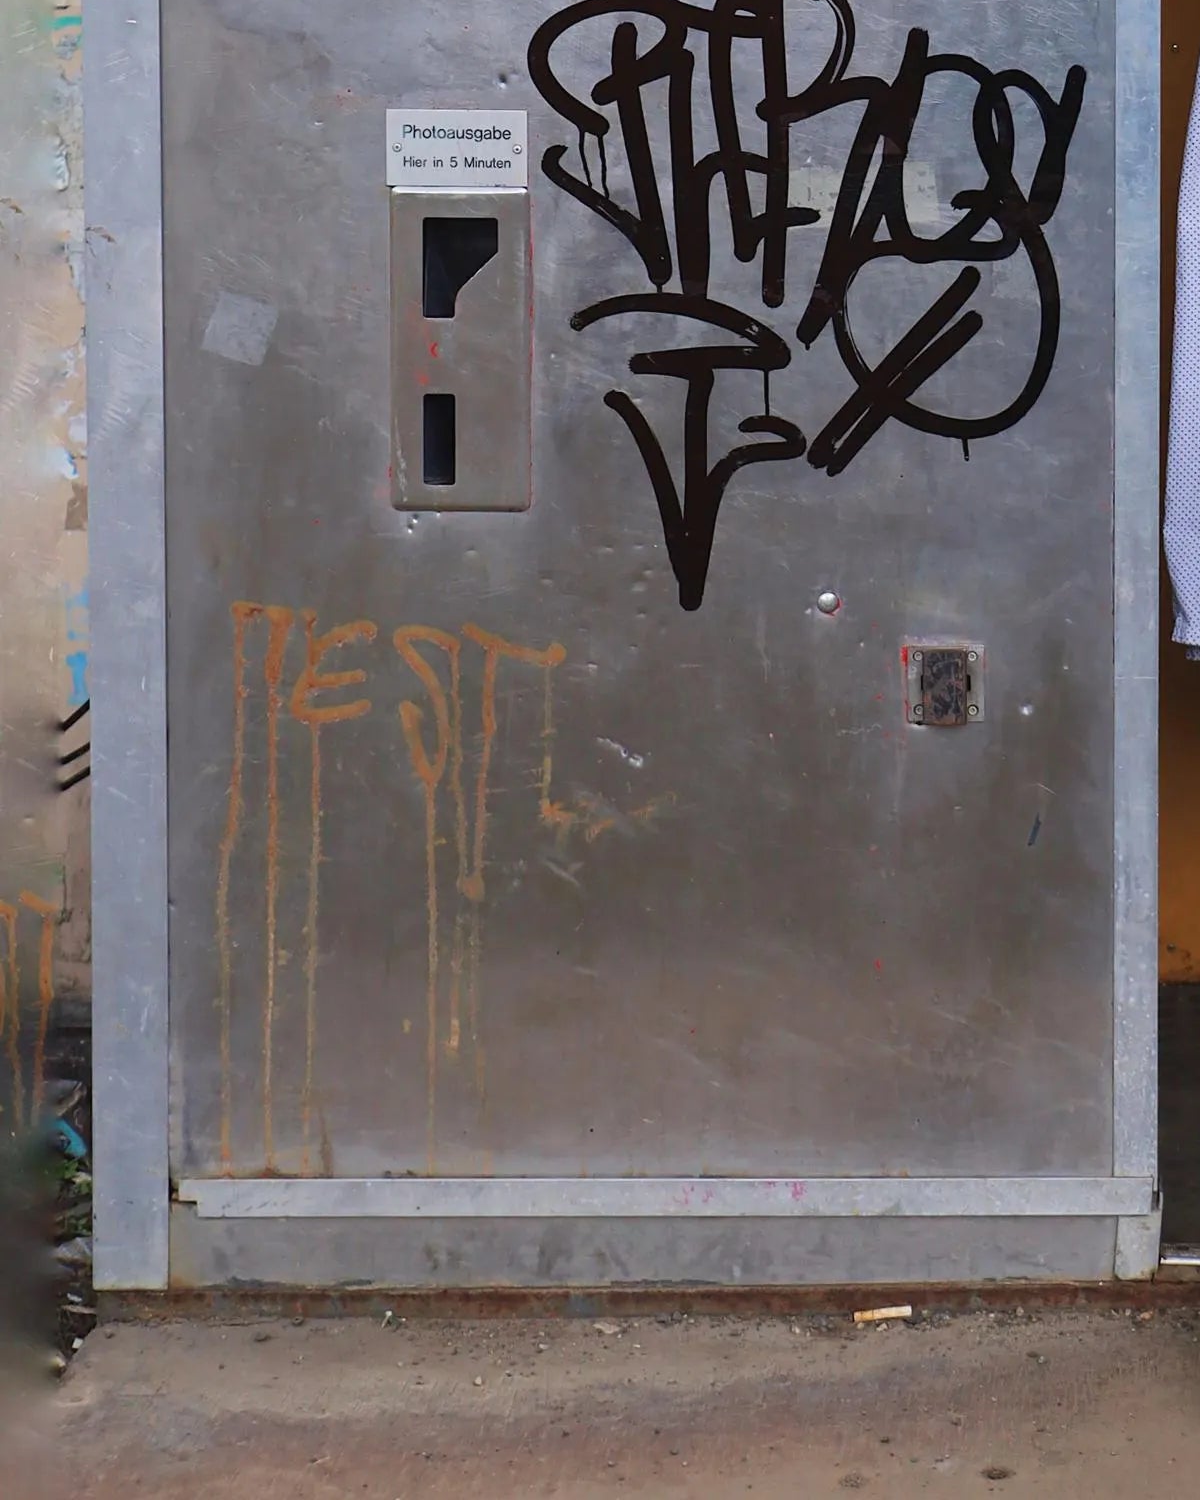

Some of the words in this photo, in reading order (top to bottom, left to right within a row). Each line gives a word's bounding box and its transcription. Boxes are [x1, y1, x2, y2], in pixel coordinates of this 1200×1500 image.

[402, 124, 512, 142] Photoausgabe
[403, 156, 427, 168] Hier
[433, 156, 444, 168] in
[449, 156, 458, 168] 5
[464, 156, 511, 169] Minuten
